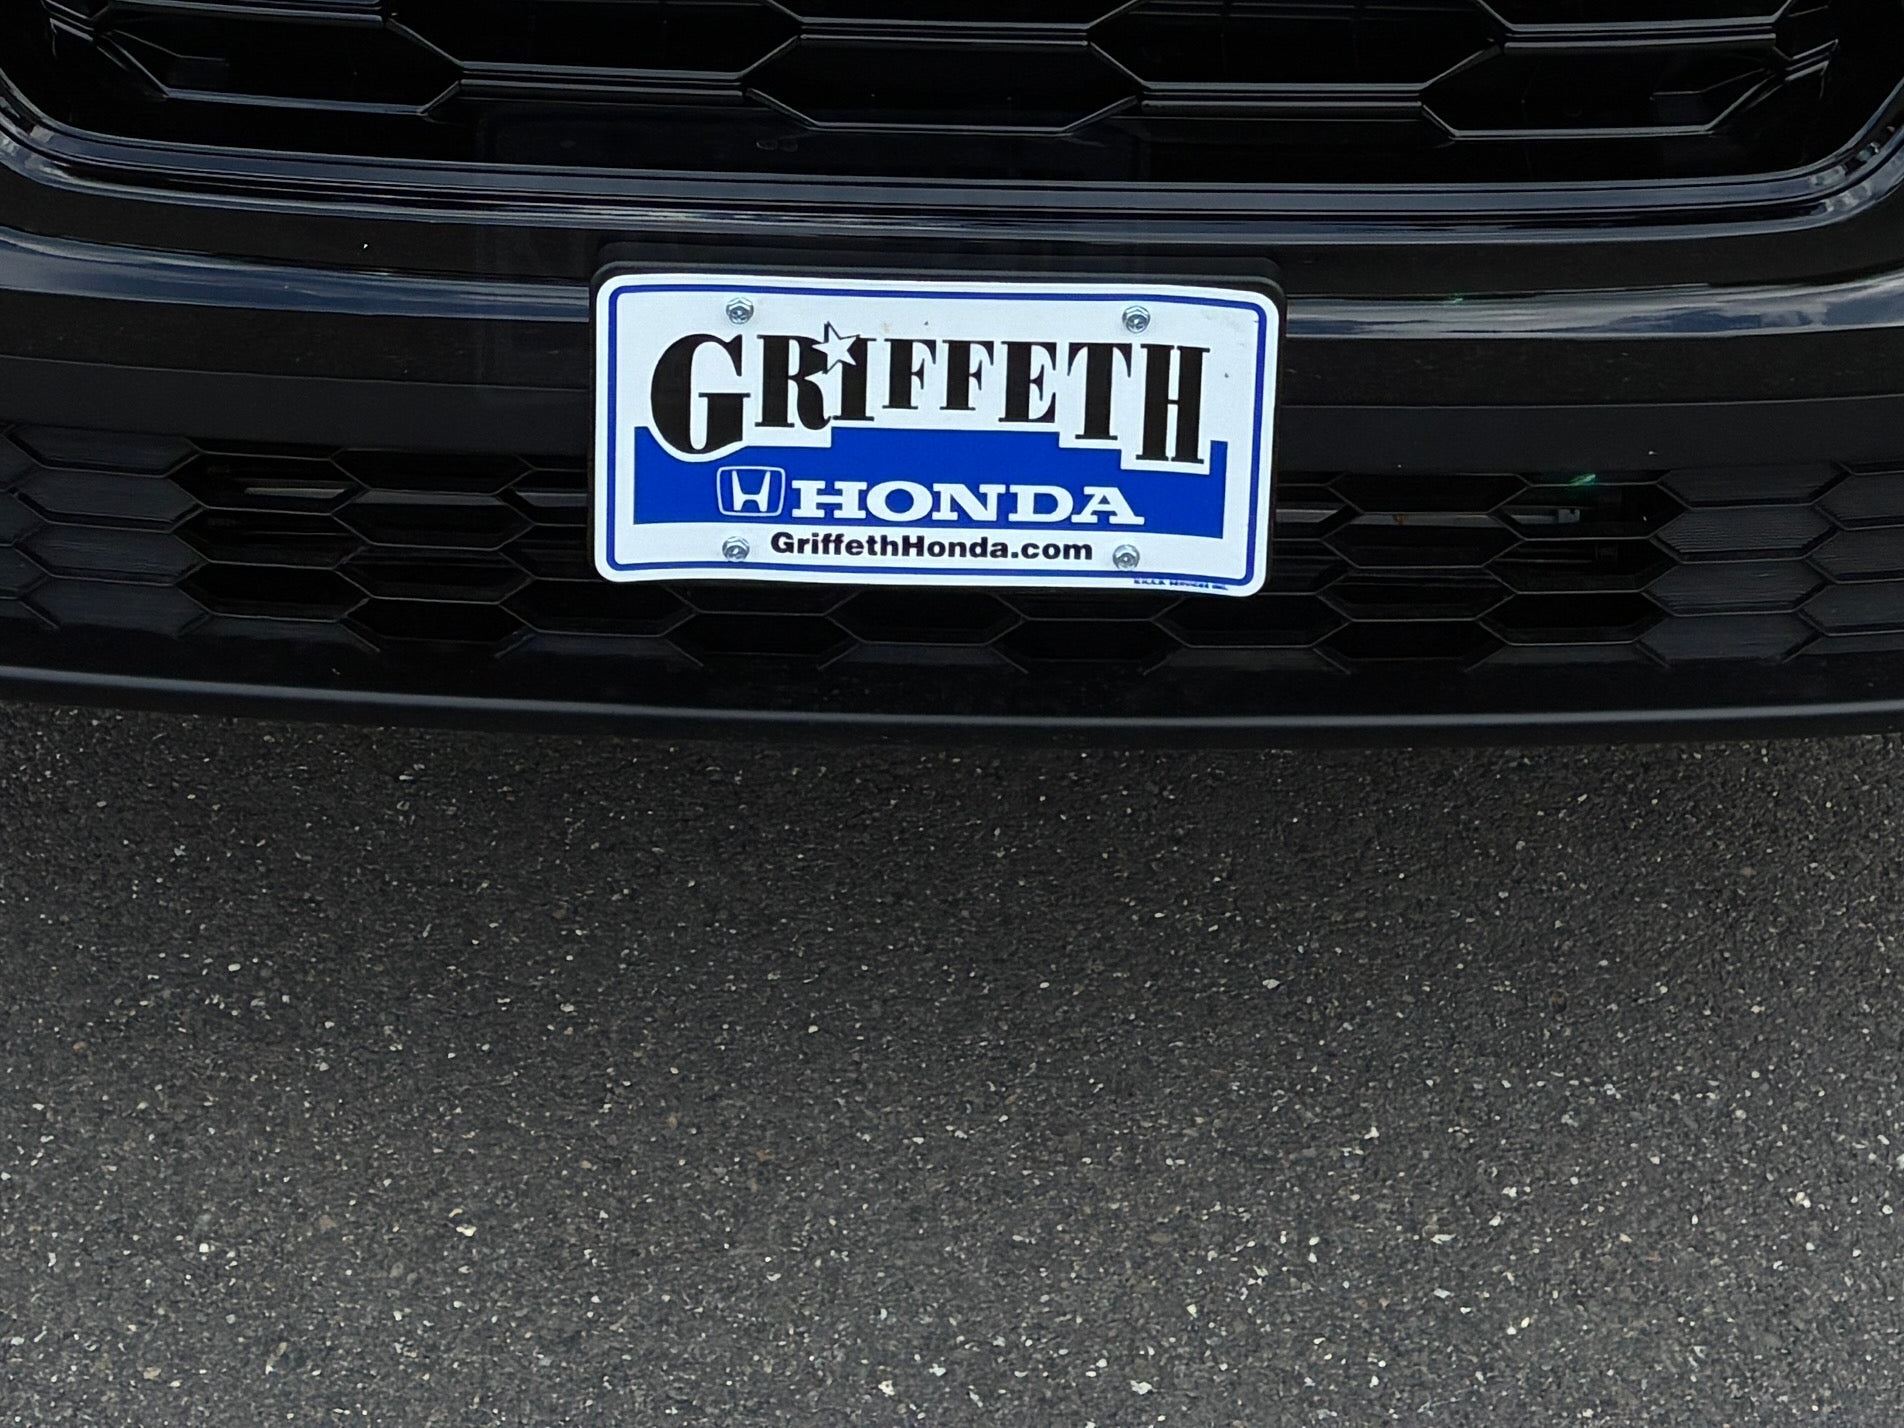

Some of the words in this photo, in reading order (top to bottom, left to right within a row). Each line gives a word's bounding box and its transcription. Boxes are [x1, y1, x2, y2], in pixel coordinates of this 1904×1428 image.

[649, 332, 1211, 465] GRIFFETH
[791, 479, 1144, 526] HONDA
[770, 531, 1093, 563] GriffethHonda.com
